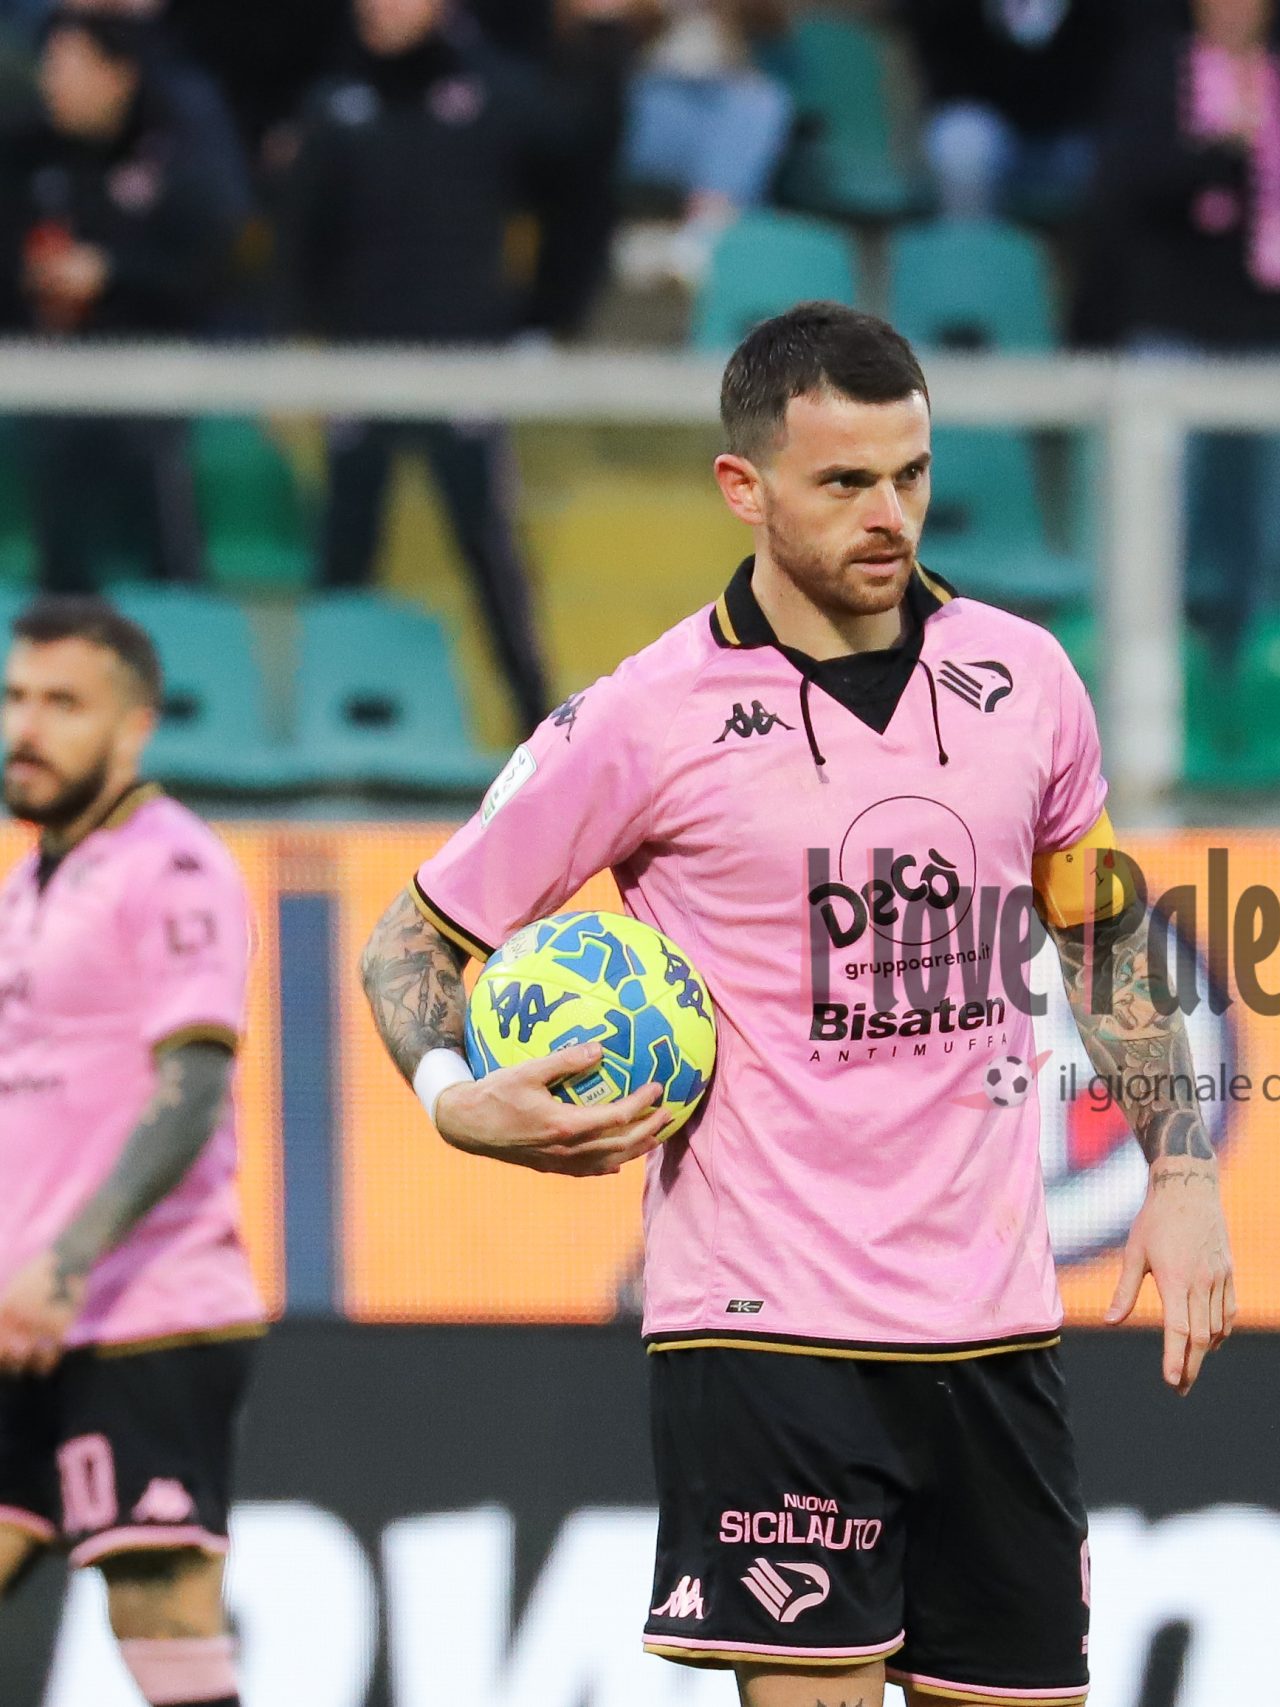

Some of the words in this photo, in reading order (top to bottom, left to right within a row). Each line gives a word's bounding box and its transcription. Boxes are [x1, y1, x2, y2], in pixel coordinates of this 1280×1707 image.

[808, 848, 960, 949] Decò
[845, 943, 991, 980] gruppoarena.it
[808, 997, 1006, 1042] Bisaten
[809, 1034, 1008, 1062] ANTIMUFFA
[784, 1493, 838, 1514] NUOVA
